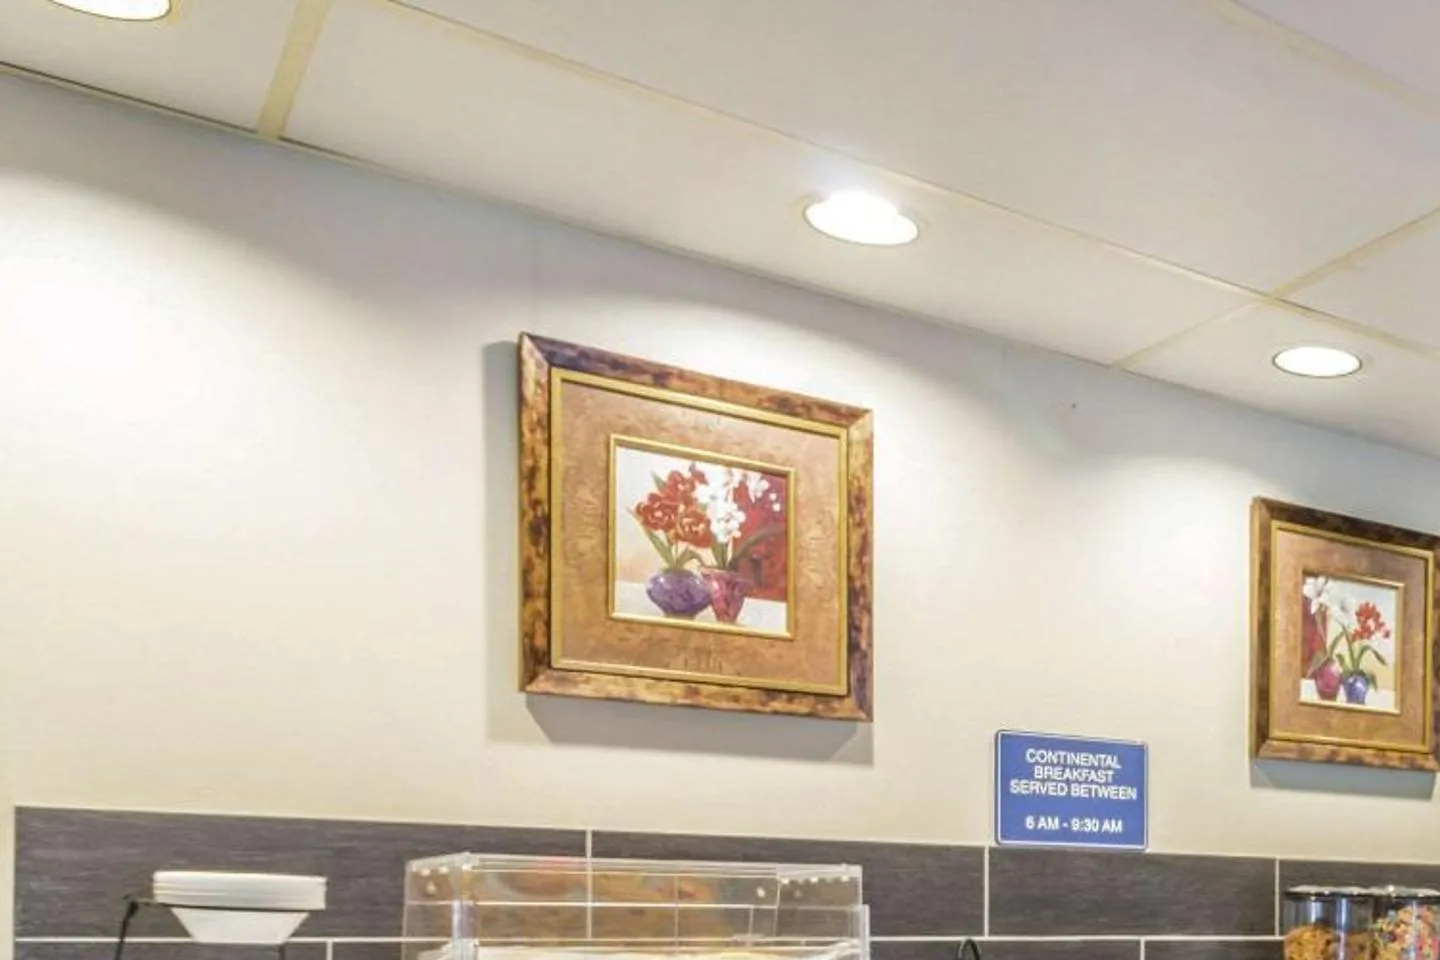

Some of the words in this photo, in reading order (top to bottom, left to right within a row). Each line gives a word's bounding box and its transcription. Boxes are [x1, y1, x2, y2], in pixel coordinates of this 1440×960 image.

[1025, 748, 1121, 769] CONTINENTAL
[1034, 766, 1114, 783] BREAKFAST
[1010, 779, 1067, 796] SERVED
[1070, 783, 1137, 800] BETWEEN
[1025, 815, 1034, 830] 6
[1037, 816, 1059, 830] AM
[1071, 817, 1099, 831] 9:30
[1101, 819, 1122, 833] AM
